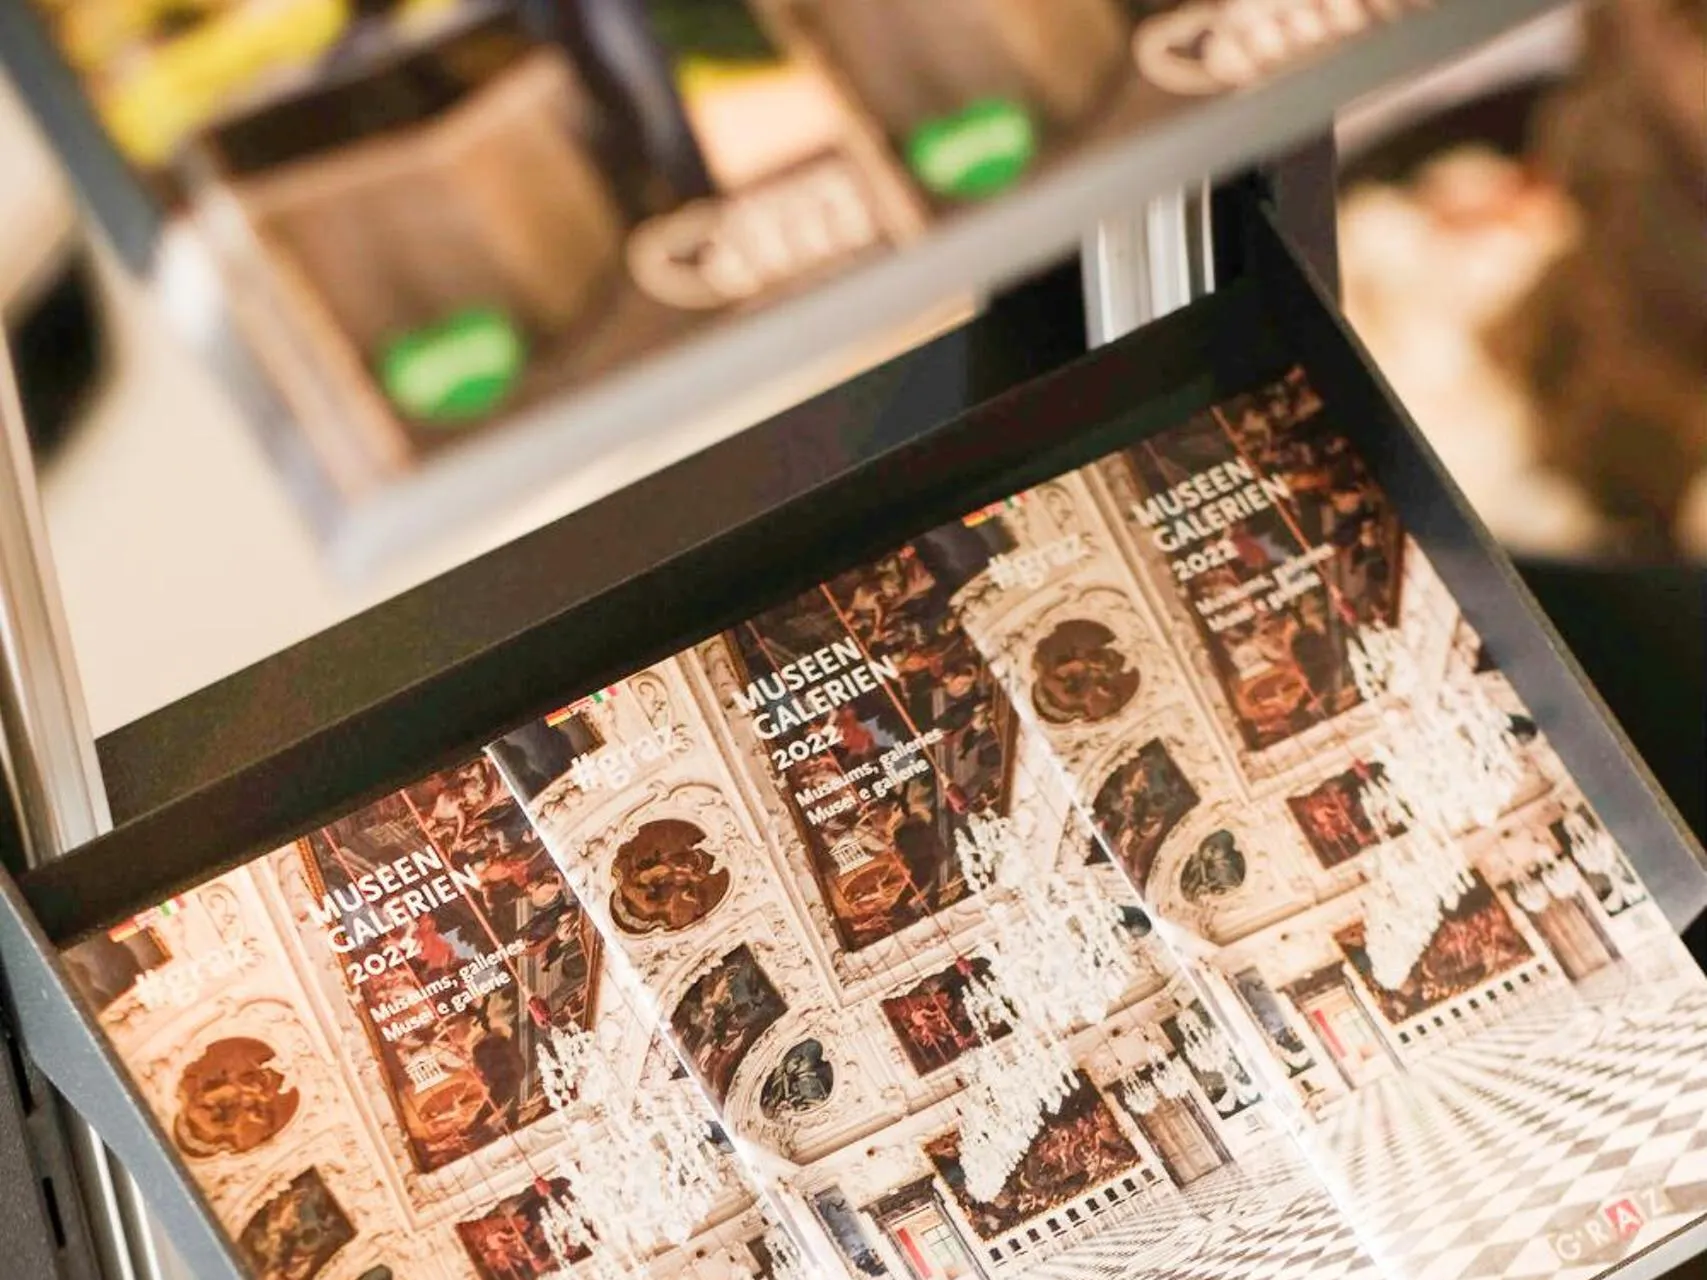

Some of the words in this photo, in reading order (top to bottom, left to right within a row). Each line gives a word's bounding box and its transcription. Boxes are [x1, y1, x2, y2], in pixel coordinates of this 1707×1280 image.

[1131, 456, 1254, 528] MUSEEN
[1152, 473, 1294, 553] GALERIEN
[1171, 539, 1240, 582] 2022
[730, 636, 862, 715] MUSEEN
[752, 655, 899, 740] GALERIEN
[771, 724, 844, 772] 2022
[306, 845, 443, 927] MUSEEN
[326, 863, 483, 953] GALERIEN
[347, 935, 423, 985] 2022
[1556, 1185, 1668, 1261] GRAZ
